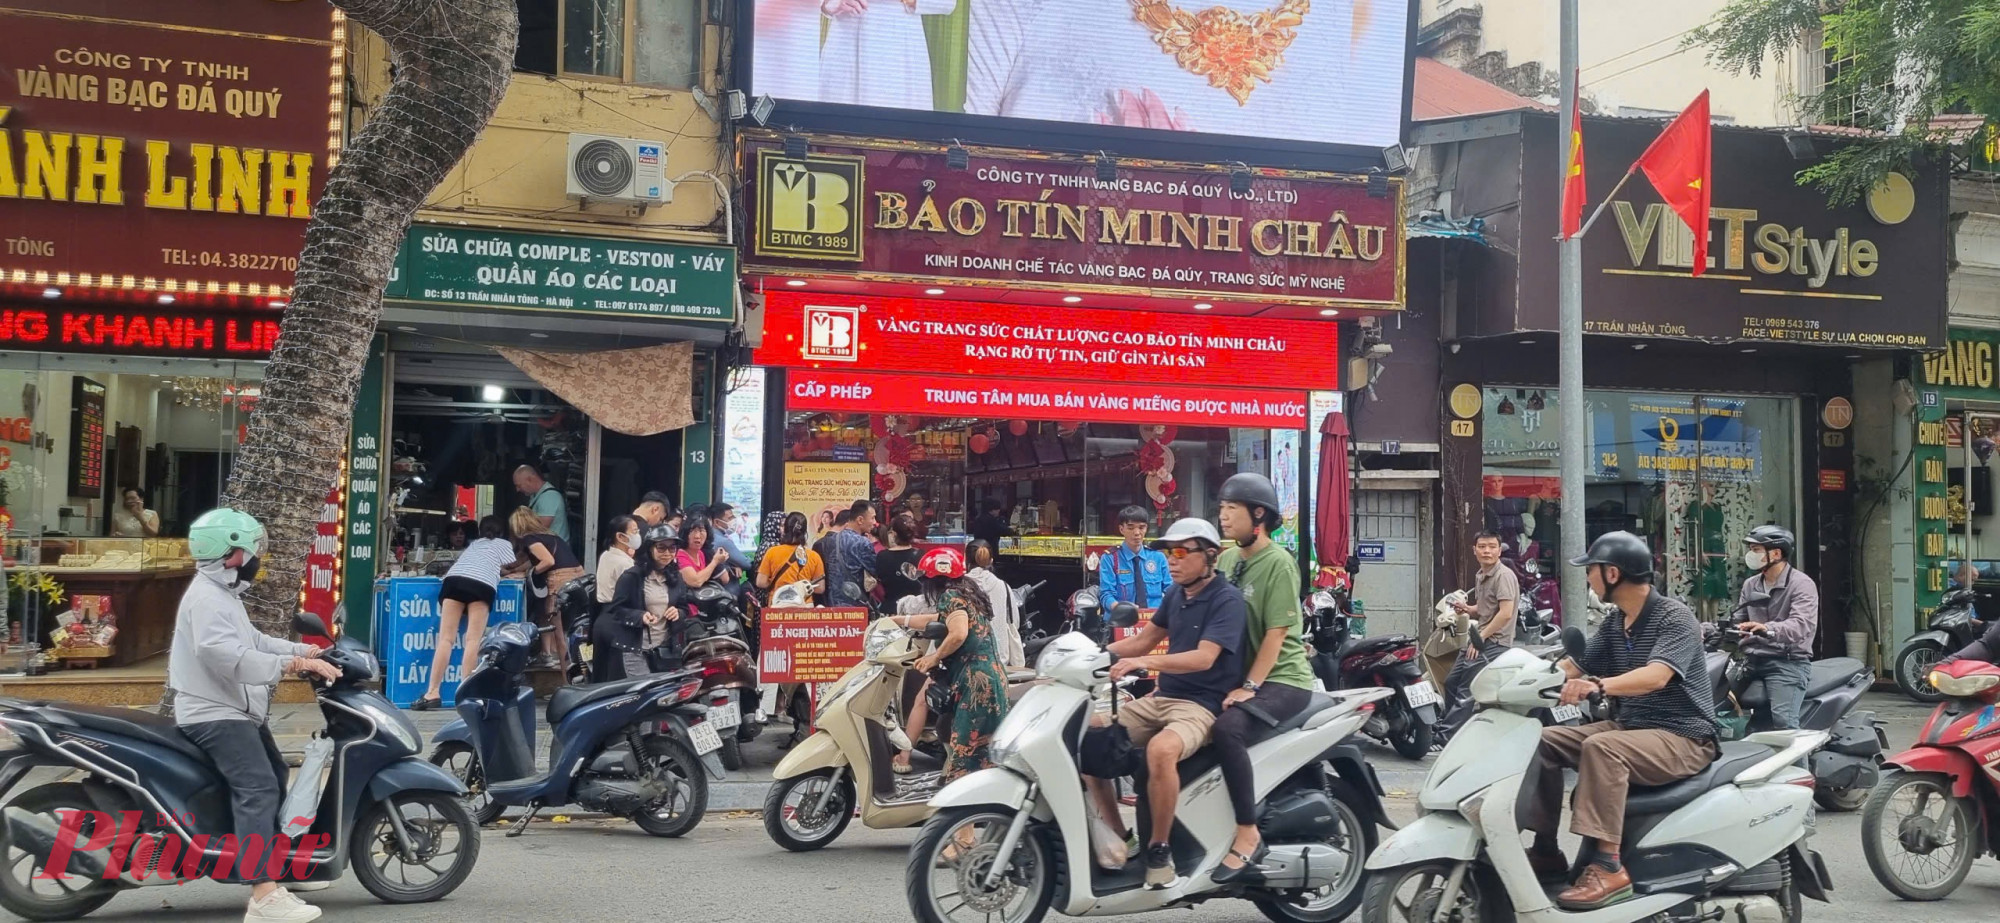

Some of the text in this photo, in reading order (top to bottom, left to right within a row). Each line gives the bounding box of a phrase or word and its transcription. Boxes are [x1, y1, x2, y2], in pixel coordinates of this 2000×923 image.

[55, 47, 249, 81] CÔNG TY TNHH
[17, 64, 282, 118] VÀNG BẠC ĐÁ QUÝ
[145, 140, 313, 219] LINH
[977, 166, 1022, 183] CÔNG
[1025, 172, 1044, 185] TY
[1049, 174, 1088, 189] TNHH
[1134, 180, 1163, 194] BẠC
[1168, 180, 1188, 196] ĐÁ
[1192, 183, 1223, 198] QUÝ
[1267, 189, 1298, 204] LTD)
[874, 179, 1387, 261] BẢO TÍN MINH CHÂU
[771, 232, 849, 248] BTMC 1989
[5, 237, 298, 271] TÔNG TEL: 04.3822710
[422, 233, 725, 272] SỬA CHỮA COMPLE VESTON VÁY
[477, 261, 677, 298] QUẦN ÁO CÁC LOẠI
[925, 254, 1345, 292] KINH DOANH CHẾ TÁC VÀNG BẠC ĐÁ TRANG SỨC MỸ NGHỆ
[424, 289, 440, 298] ĐC:
[441, 288, 453, 299] SỐ
[455, 291, 465, 300] 13
[468, 290, 490, 302] TRẦN
[491, 293, 515, 303] NHÂN
[517, 294, 539, 305] TÔNG
[546, 296, 557, 305] HÀ
[559, 297, 573, 308] NỘI
[703, 306, 721, 315] 7314
[62, 313, 281, 350] KHANH LIN
[876, 316, 1286, 351] VÀNG TRANG SỨC CHẤT LƯỢNG CAO BẢO TÍN MINH CHÂU
[1584, 319, 1685, 334] 17 TRẦN NHÂN TÔNG
[1765, 318, 1785, 327] 0969
[1787, 319, 1803, 328] 543
[1805, 320, 1820, 329] 376
[1821, 332, 1835, 342] SỰ
[1837, 333, 1856, 343] LỰA
[1859, 333, 1884, 345] CHỌN
[1886, 334, 1905, 344] CHO
[965, 344, 1205, 368] RẠNG RỠ TỰ TIN, GIỮ GÌN TÀI SẢN
[794, 380, 826, 398] CẤP
[830, 381, 872, 400] PHÉP
[924, 388, 977, 404] TRUNG
[981, 388, 1013, 405] TÂM
[1017, 394, 1050, 408] MUA
[1054, 391, 1084, 408] BÁN
[1088, 392, 1129, 410] VÀNG
[1132, 394, 1181, 412] MIẾNG
[1185, 399, 1227, 417] ĐƯỢC
[1231, 397, 1261, 415] NHÀ
[1264, 399, 1305, 417] NƯỚC
[1925, 394, 1935, 405] 19
[1456, 423, 1469, 434] 17
[357, 432, 376, 450] SỬA
[1385, 441, 1398, 453] 17
[1829, 434, 1840, 445] 17
[354, 456, 377, 470] CHỮA
[690, 450, 705, 464] 13
[1925, 456, 1943, 482] BÁN
[357, 500, 370, 515] ÁO
[352, 522, 371, 535] CÁC
[351, 546, 371, 561] LOẠI
[400, 594, 431, 618] SỬA
[495, 600, 515, 615] LOẠI
[765, 611, 783, 620] CÔNG
[784, 612, 793, 620] AN
[771, 623, 860, 640] ĐỀ NGHỊ NHÂN DÂN
[763, 647, 787, 674] KHÔNG
[399, 660, 428, 684] LẤY
[711, 714, 736, 729] 6321
